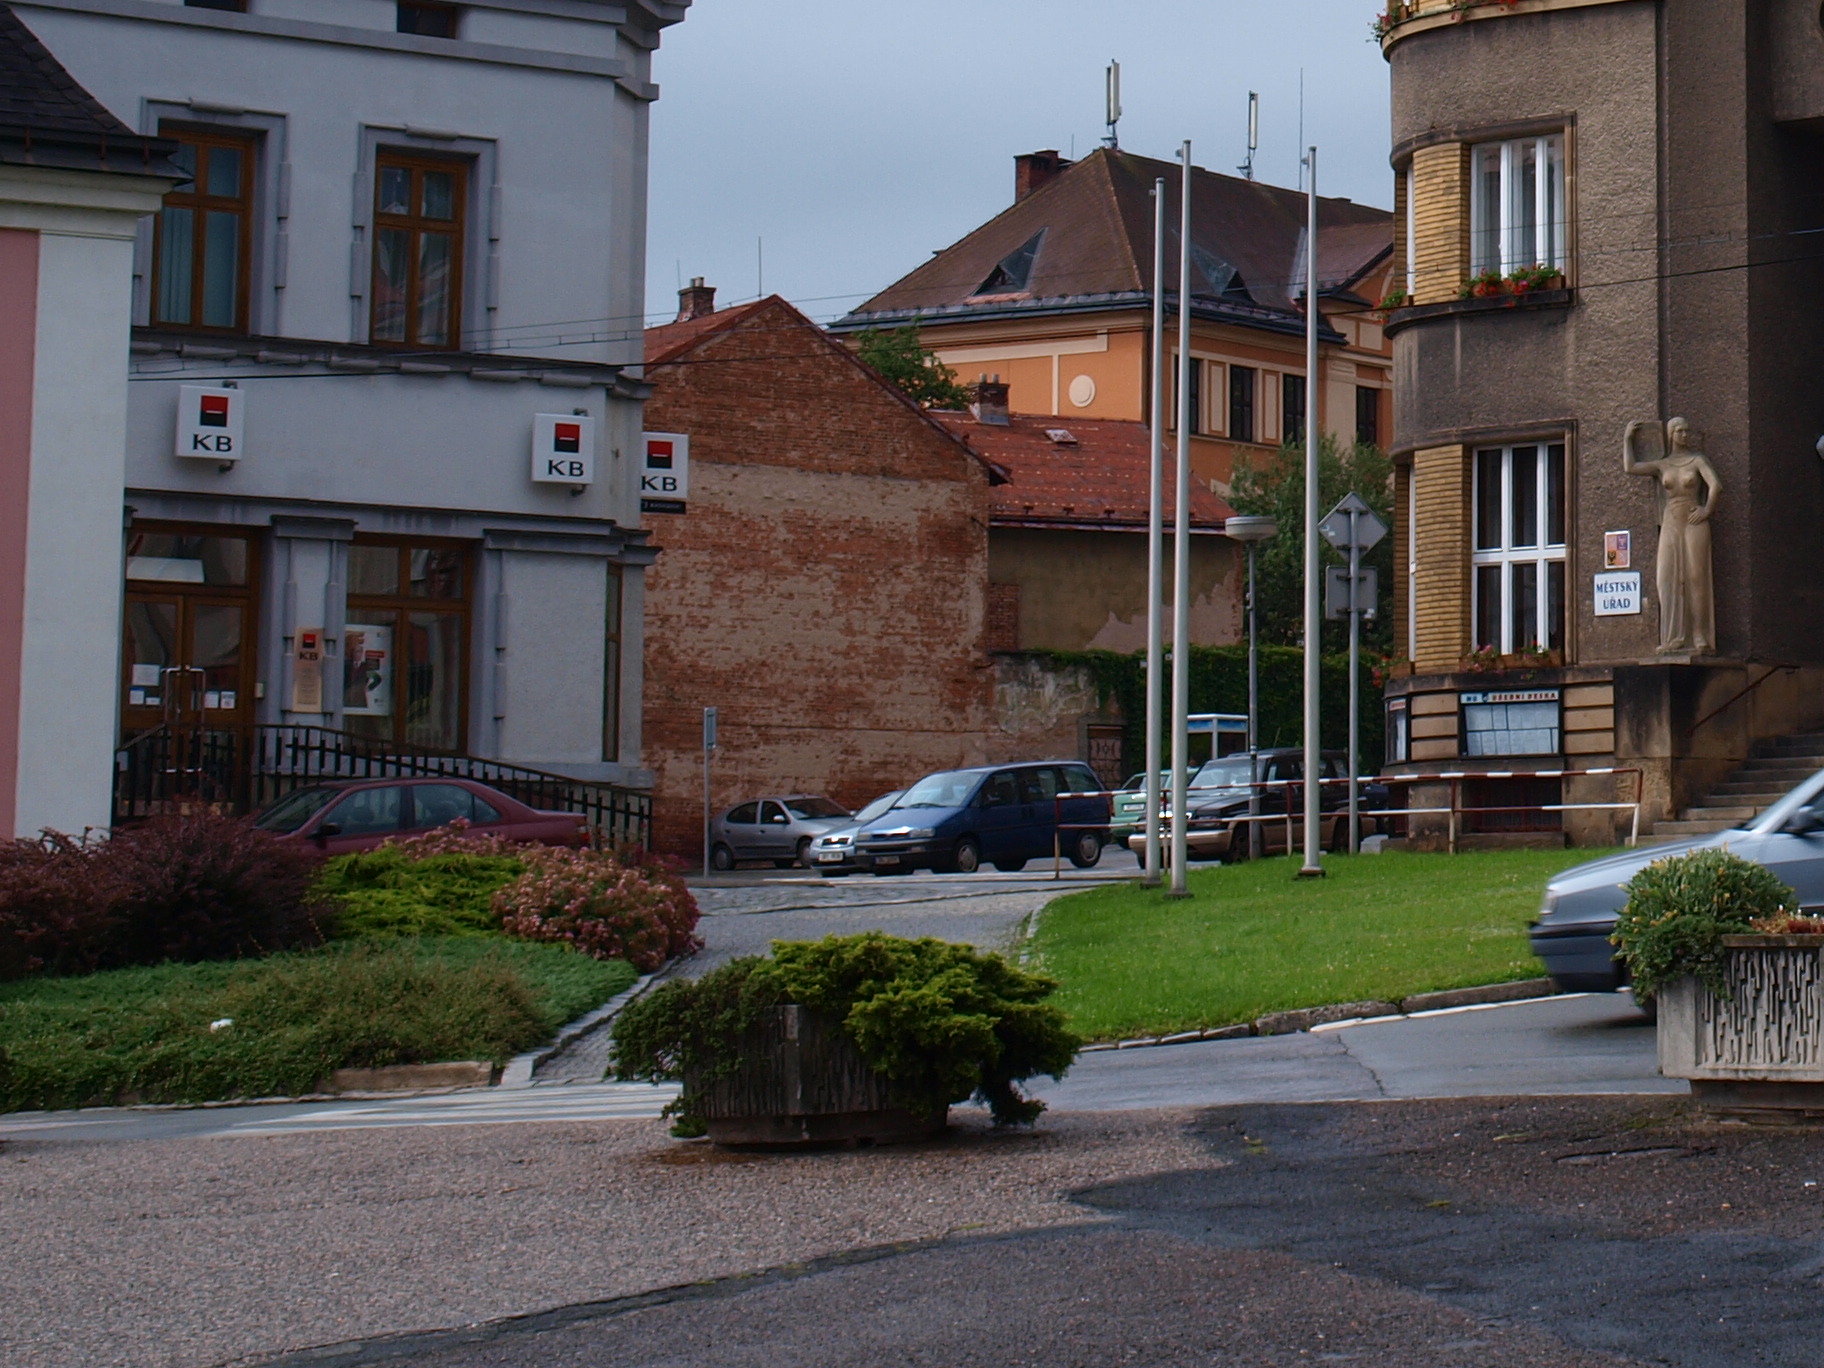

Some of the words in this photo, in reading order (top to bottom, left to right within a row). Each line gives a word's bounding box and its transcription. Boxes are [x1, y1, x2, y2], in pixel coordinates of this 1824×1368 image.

[192, 433, 232, 452] KB
[548, 460, 584, 476] KB
[641, 476, 677, 492] KB
[1596, 578, 1638, 593] MĚSTSKÝ
[299, 652, 319, 661] KB
